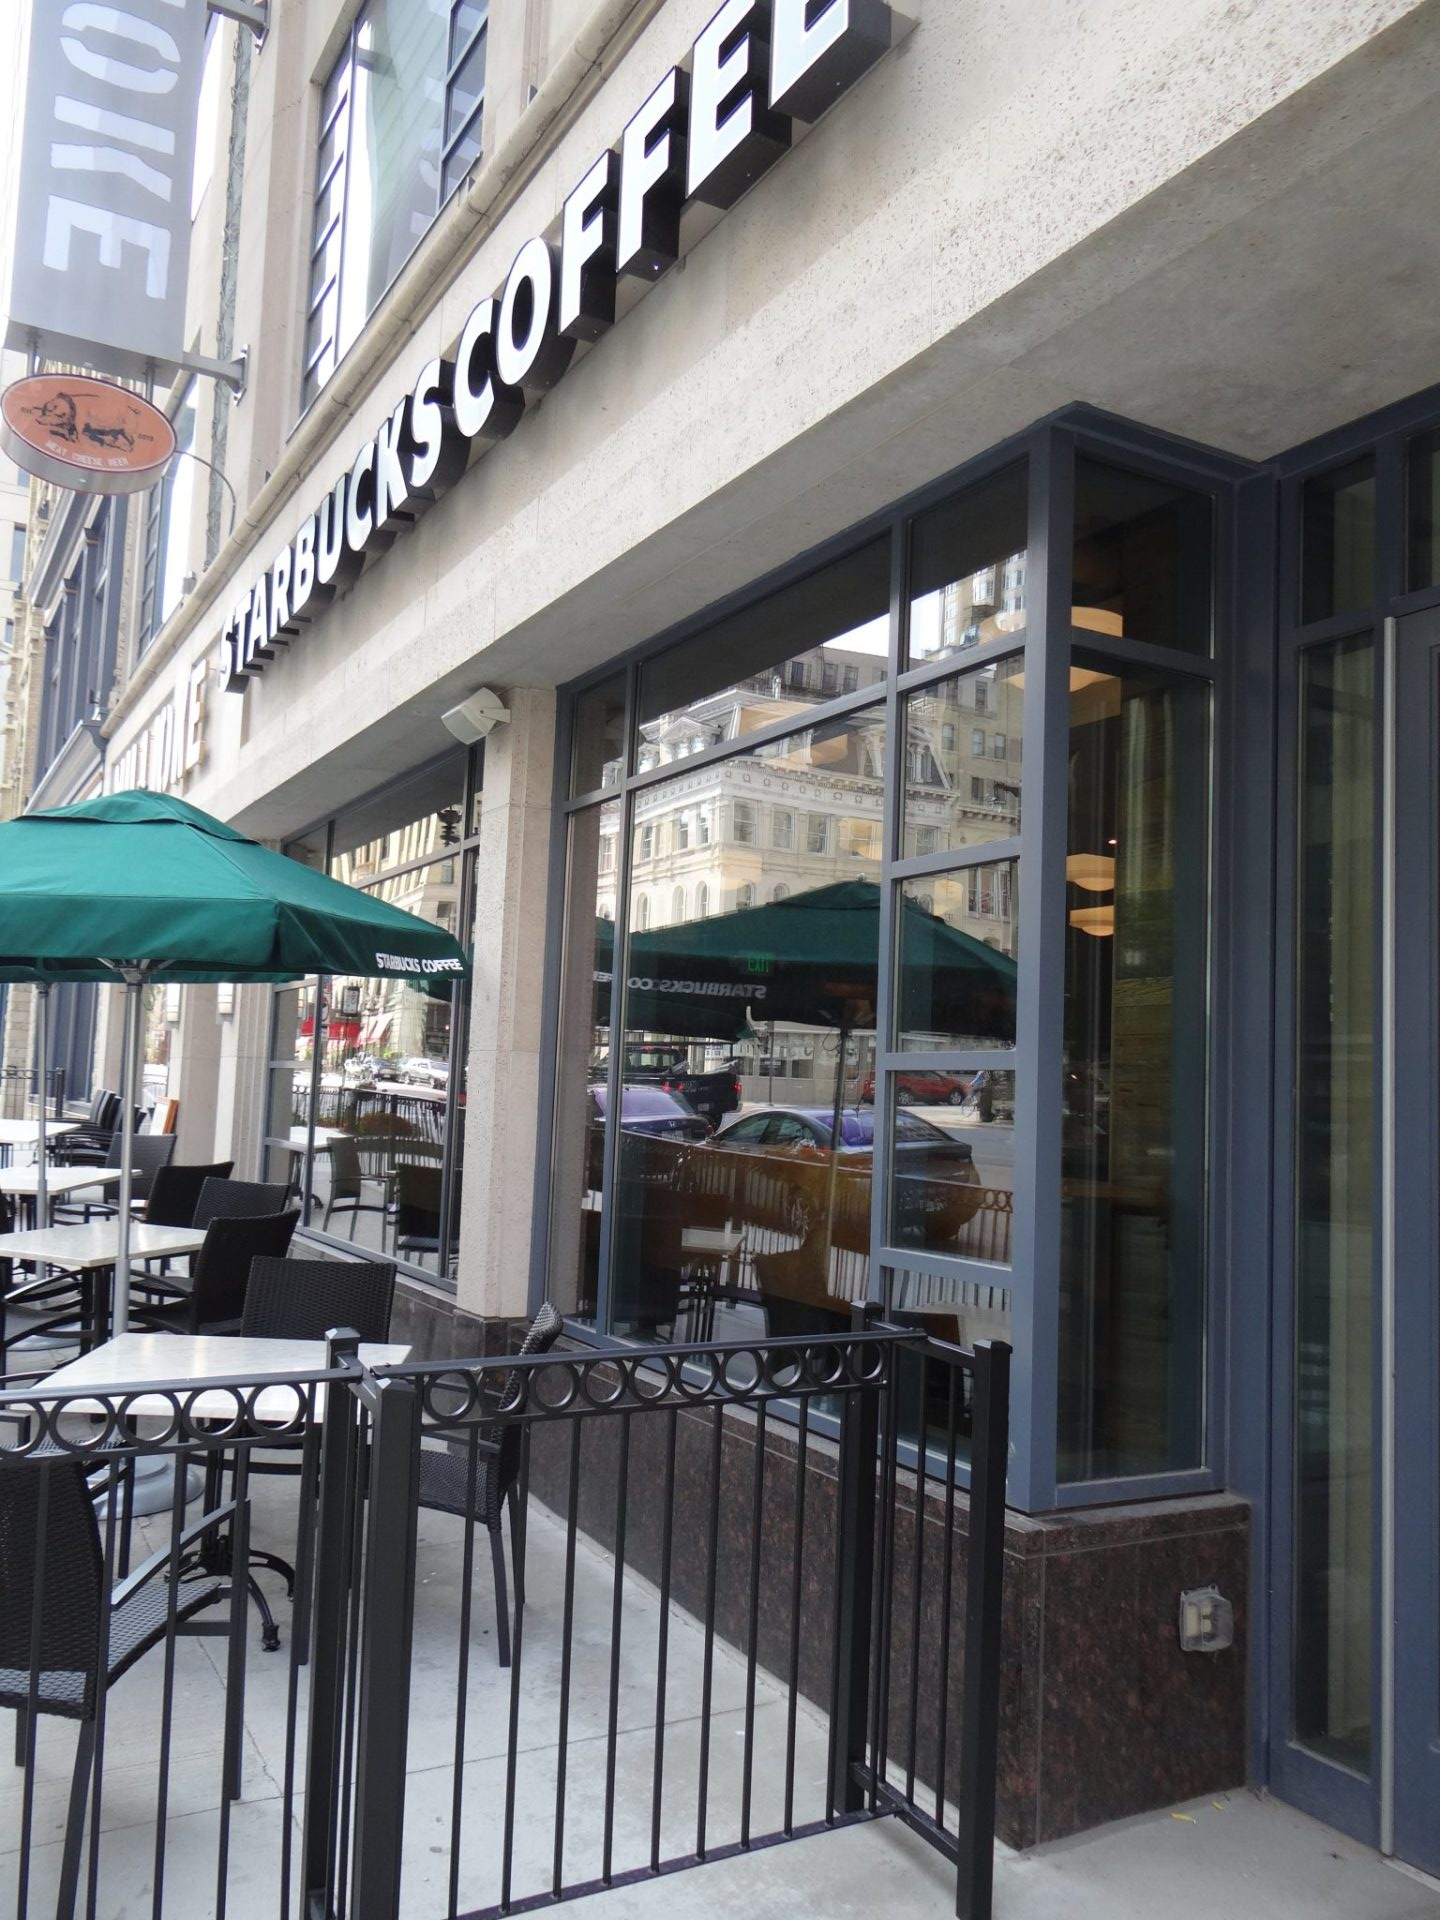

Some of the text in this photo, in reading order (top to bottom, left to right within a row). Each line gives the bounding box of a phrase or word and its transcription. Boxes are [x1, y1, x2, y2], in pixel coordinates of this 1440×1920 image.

[42, 0, 190, 300] OKE
[71, 452, 103, 467] CHEESE
[217, 357, 443, 694] STARBUCKS
[375, 952, 464, 973] STARBUCKS COFFEE
